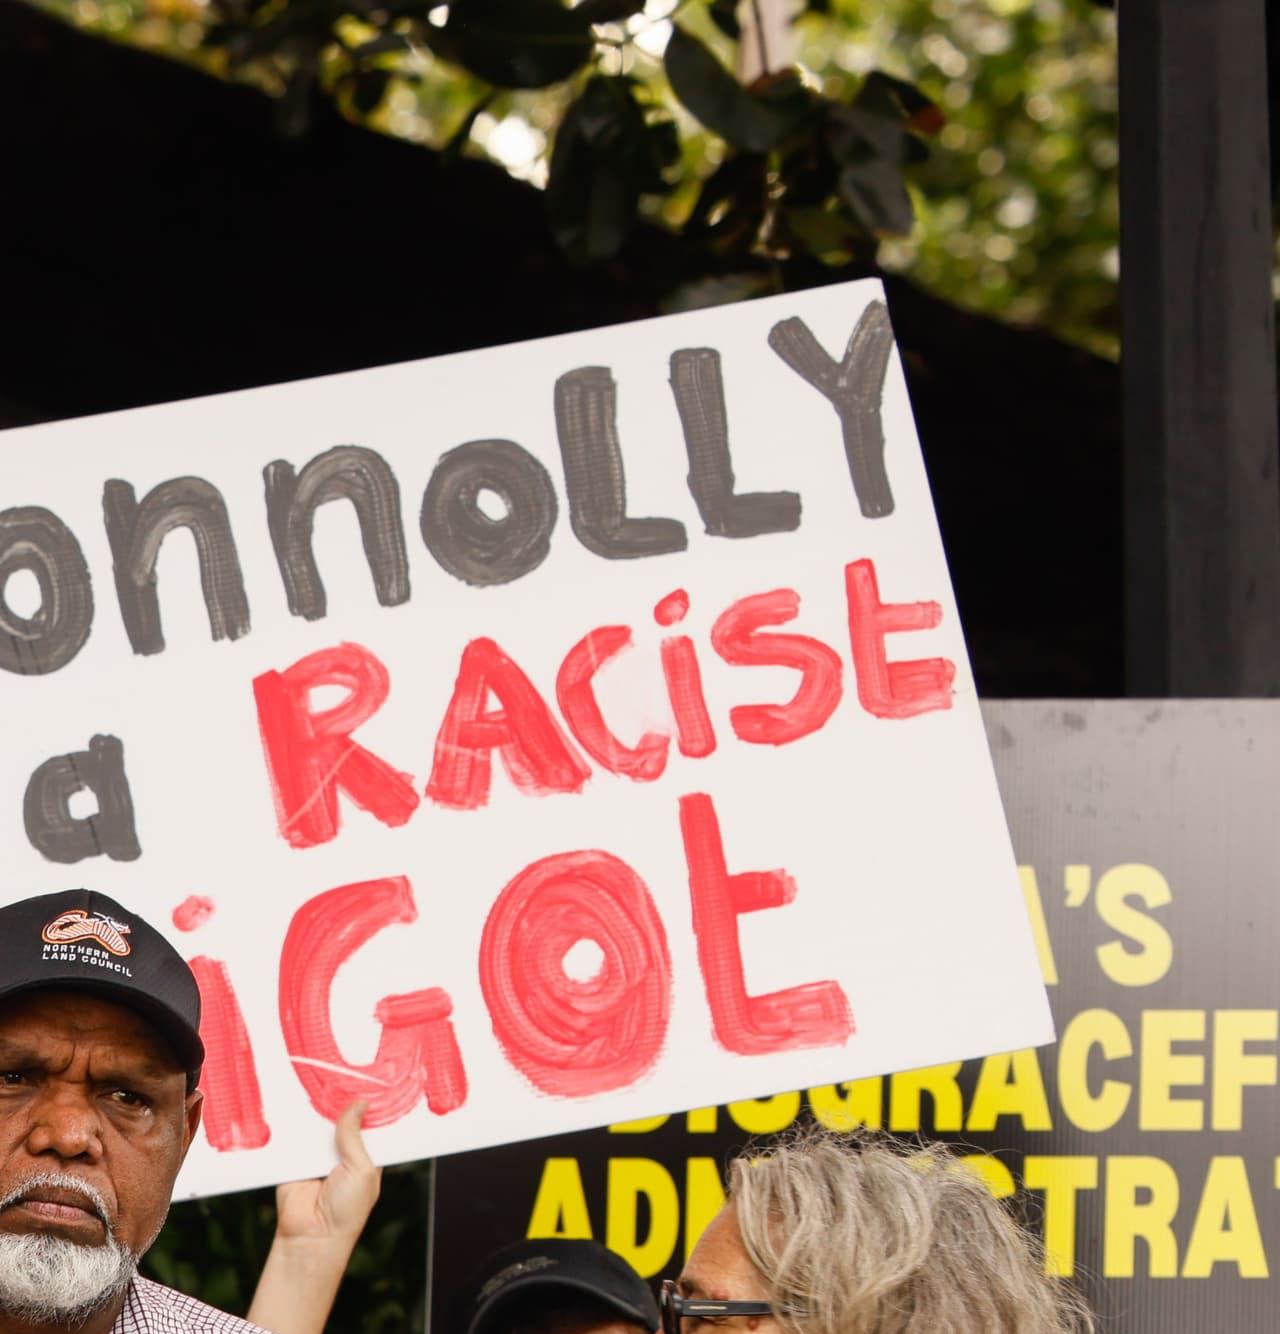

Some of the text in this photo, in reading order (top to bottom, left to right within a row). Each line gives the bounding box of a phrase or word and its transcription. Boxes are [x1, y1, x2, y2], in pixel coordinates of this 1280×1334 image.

[23, 734, 142, 864] a
[42, 952, 133, 977] LAND COUNCIL
[43, 944, 109, 960] NORTHERN
